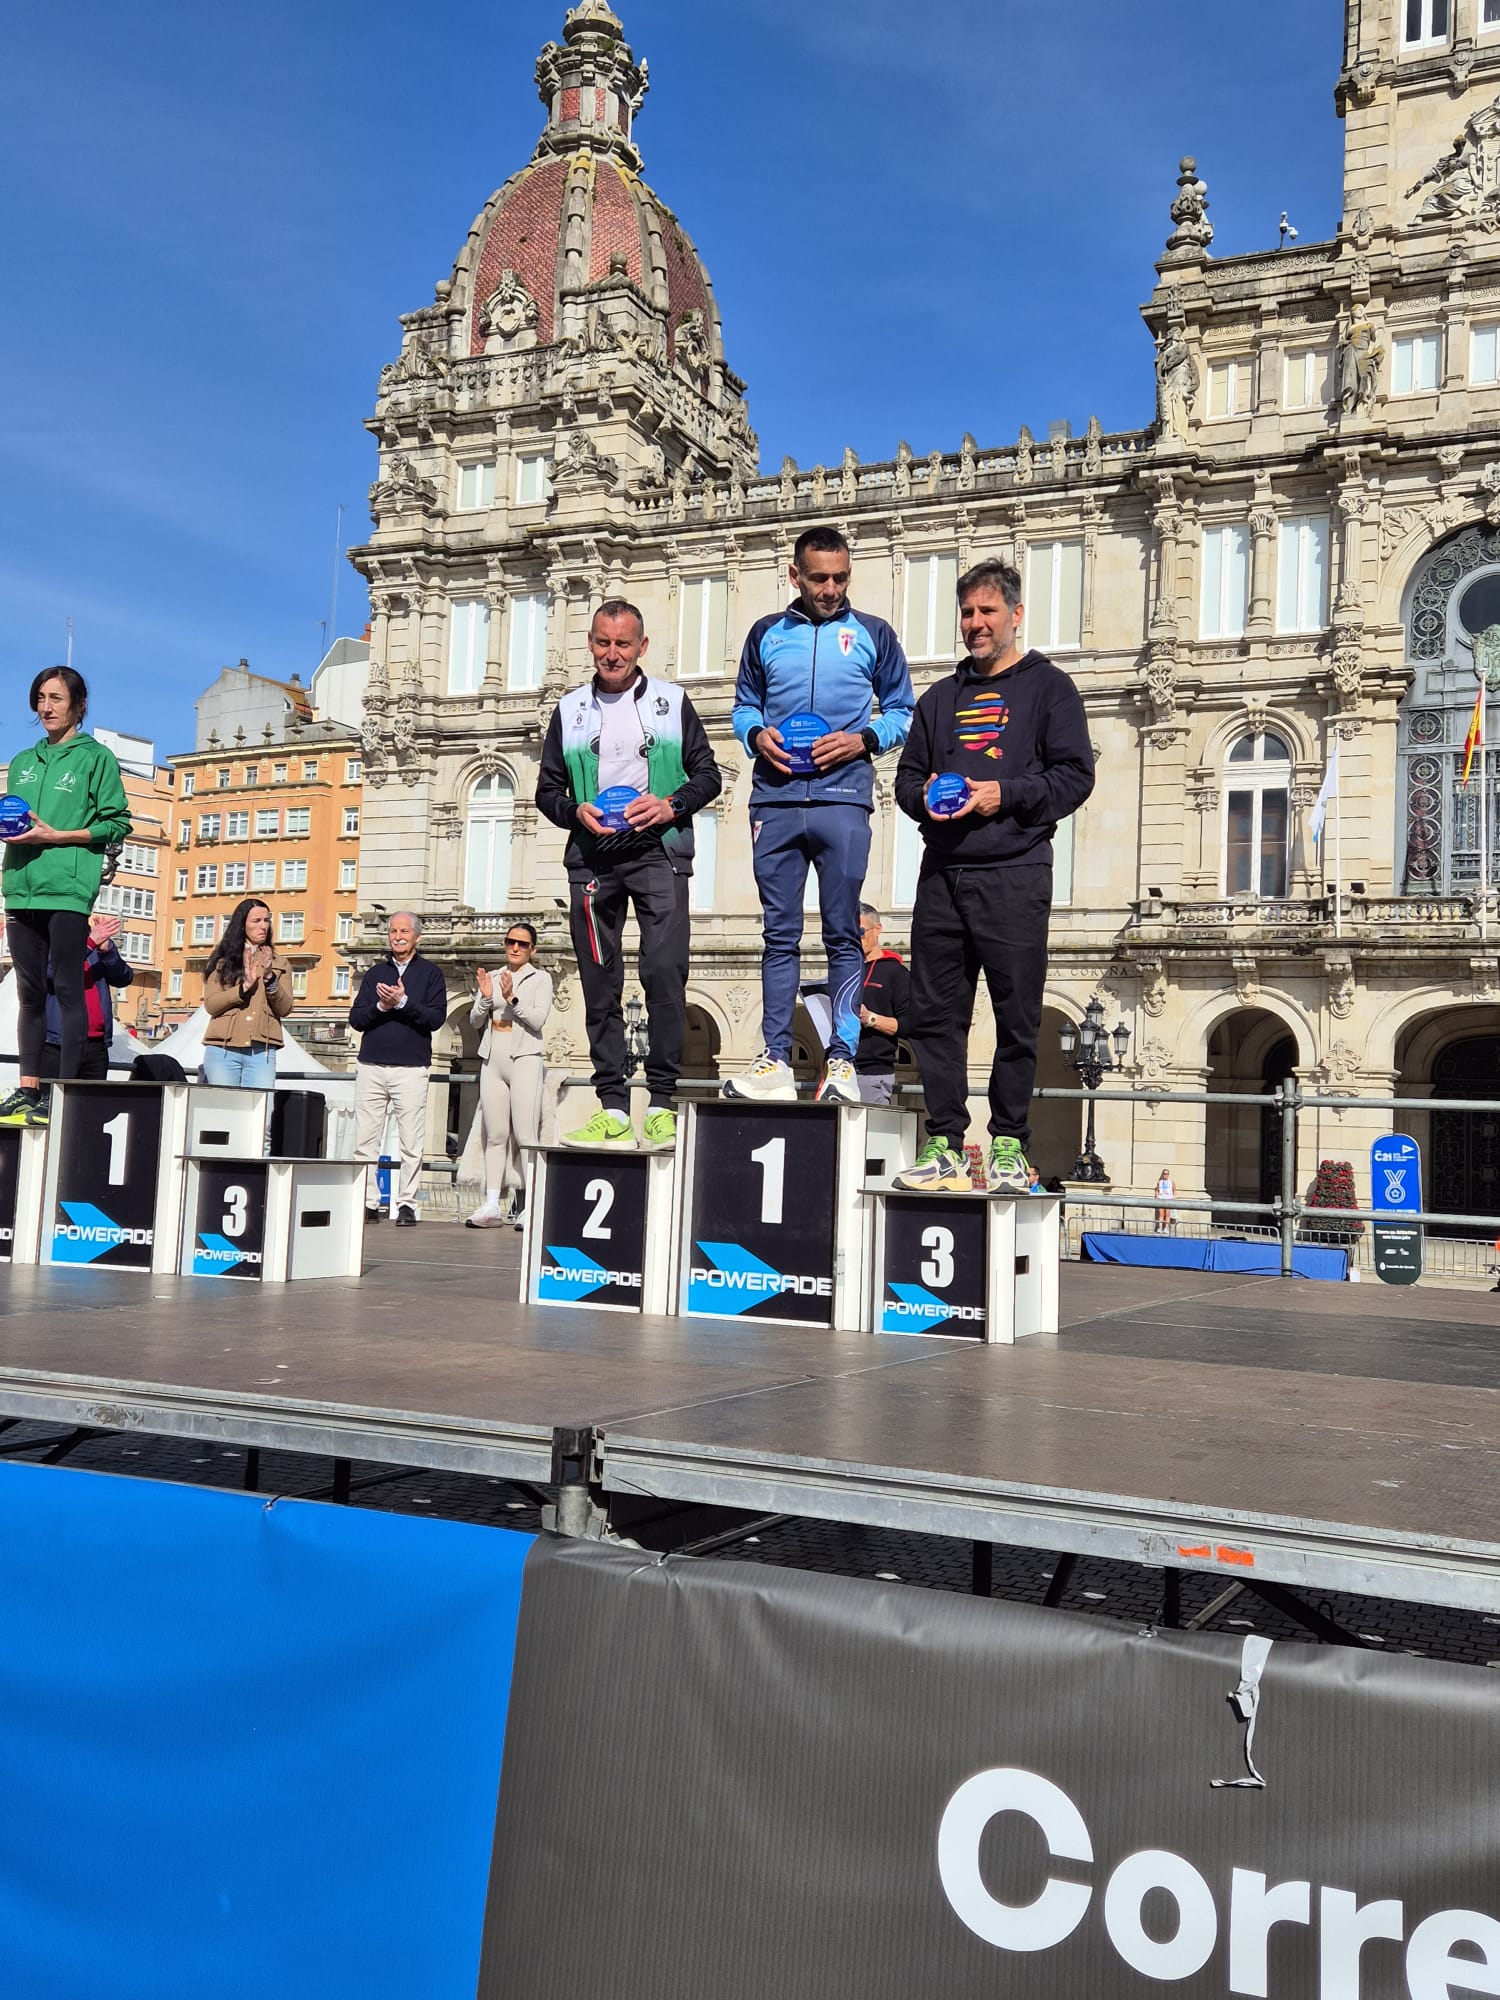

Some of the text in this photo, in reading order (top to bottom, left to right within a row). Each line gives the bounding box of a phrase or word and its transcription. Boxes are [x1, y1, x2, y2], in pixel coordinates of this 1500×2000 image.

[1071, 965, 1128, 976] CORVÑA
[102, 1112, 129, 1186] 1
[751, 1137, 786, 1224] 1
[54, 1223, 153, 1245] POWERADE
[222, 1185, 248, 1237] 3
[581, 1178, 615, 1240] 2
[540, 1265, 642, 1288] POWERADE
[690, 1267, 833, 1297] POWERADE
[920, 1226, 955, 1288] 3
[883, 1300, 987, 1321] POWERADE
[937, 1767, 1500, 2000] Corre
